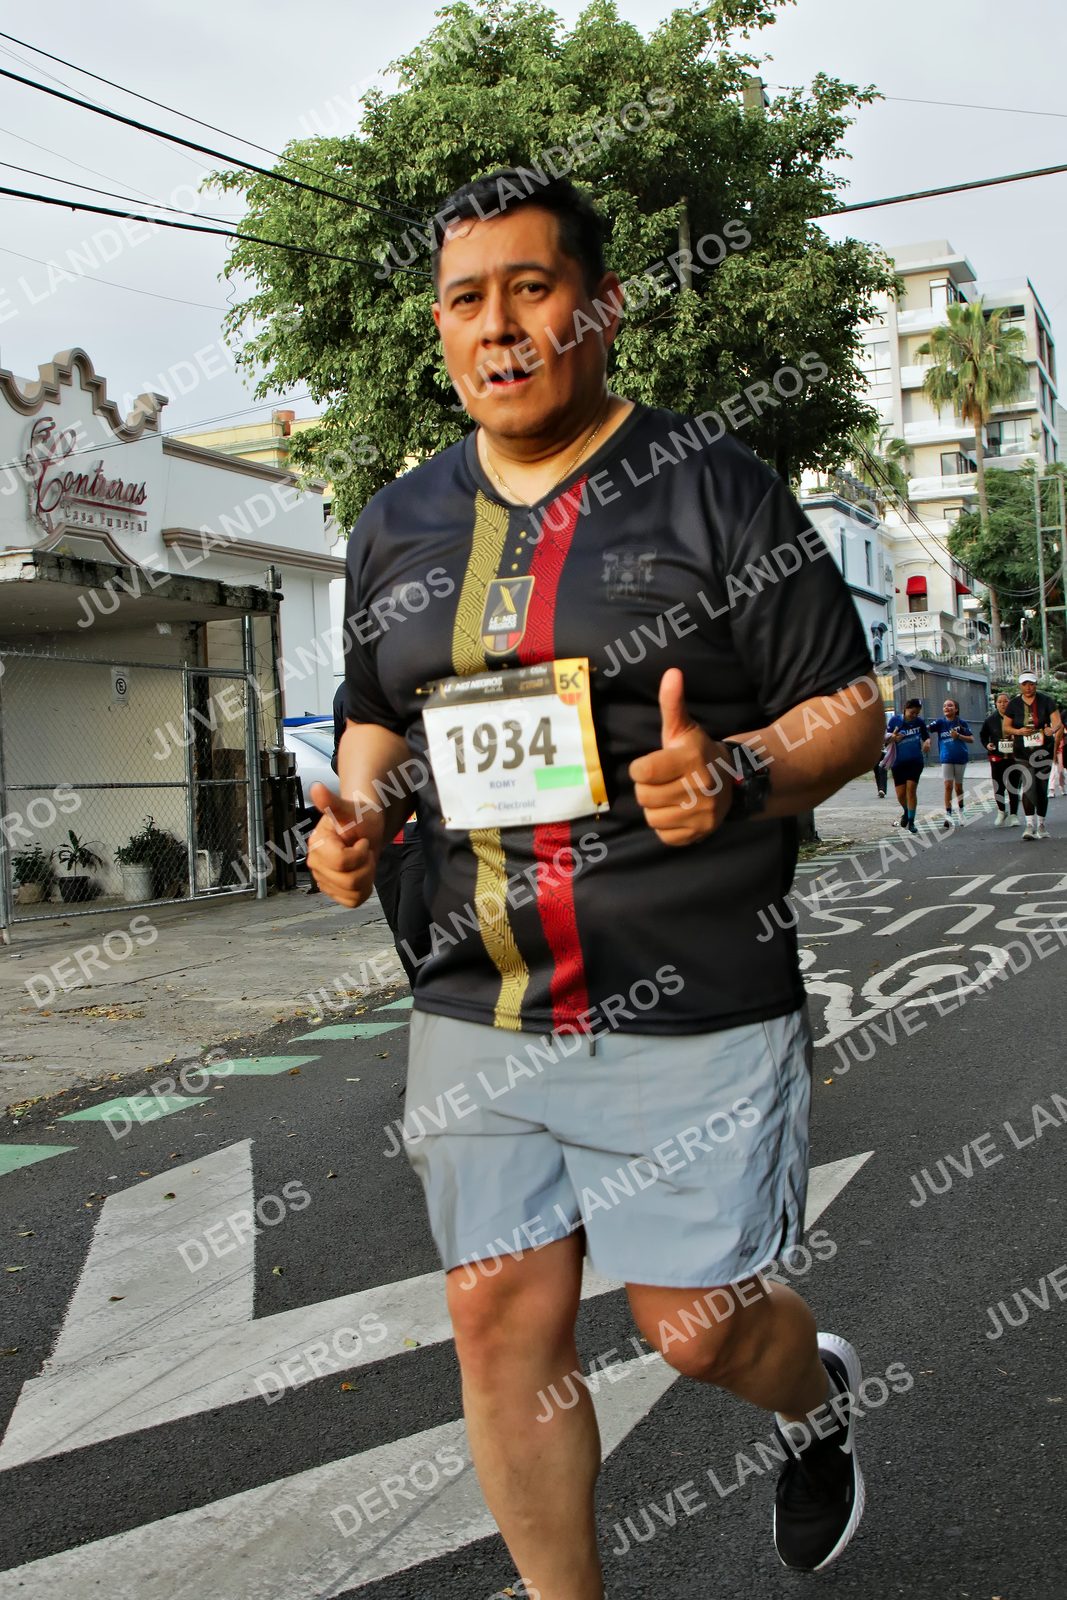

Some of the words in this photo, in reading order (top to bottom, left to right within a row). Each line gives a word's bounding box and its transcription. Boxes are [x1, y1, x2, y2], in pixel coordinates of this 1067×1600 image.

[64, 505, 94, 523] Casa
[559, 671, 581, 690] 5K
[446, 716, 557, 774] 1934
[489, 779, 516, 789] ROMY
